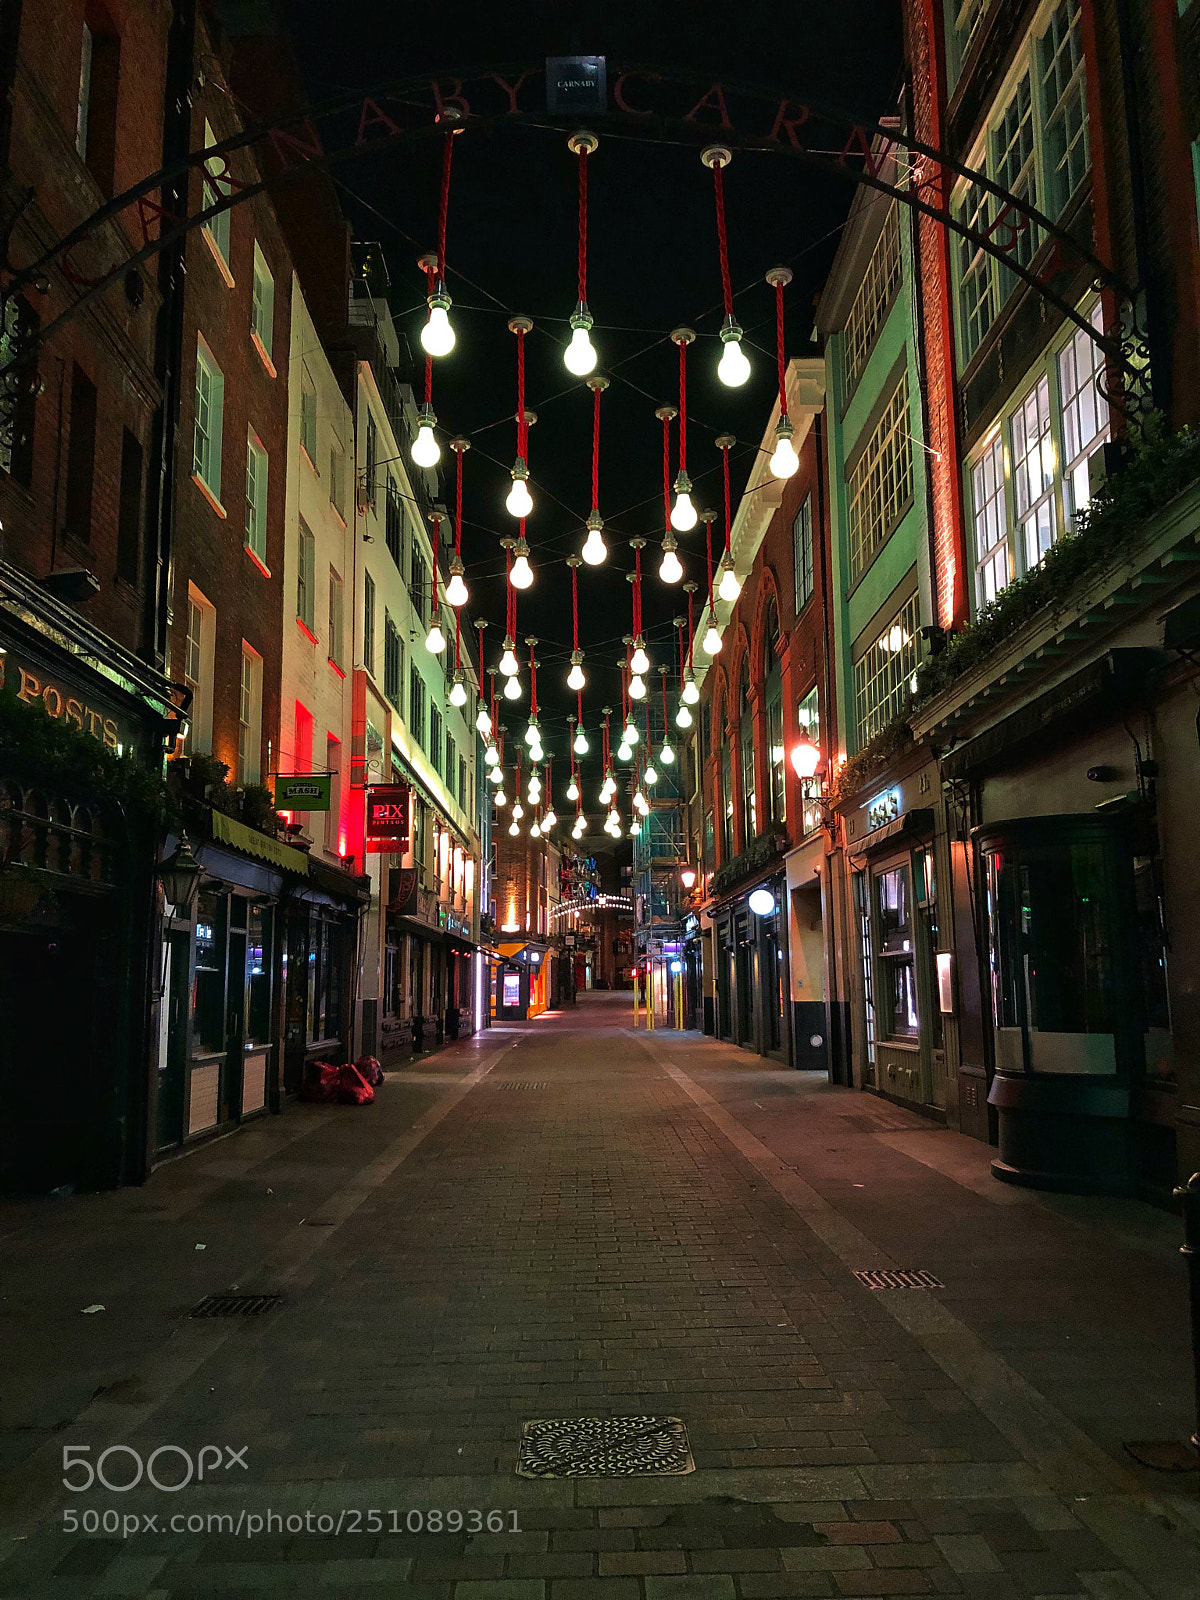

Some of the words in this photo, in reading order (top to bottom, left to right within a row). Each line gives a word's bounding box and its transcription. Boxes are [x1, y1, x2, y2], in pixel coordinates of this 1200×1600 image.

[557, 80, 595, 88] CARNABY
[16, 665, 119, 748] POSTS
[288, 787, 319, 795] MASH
[372, 804, 404, 818] PIX
